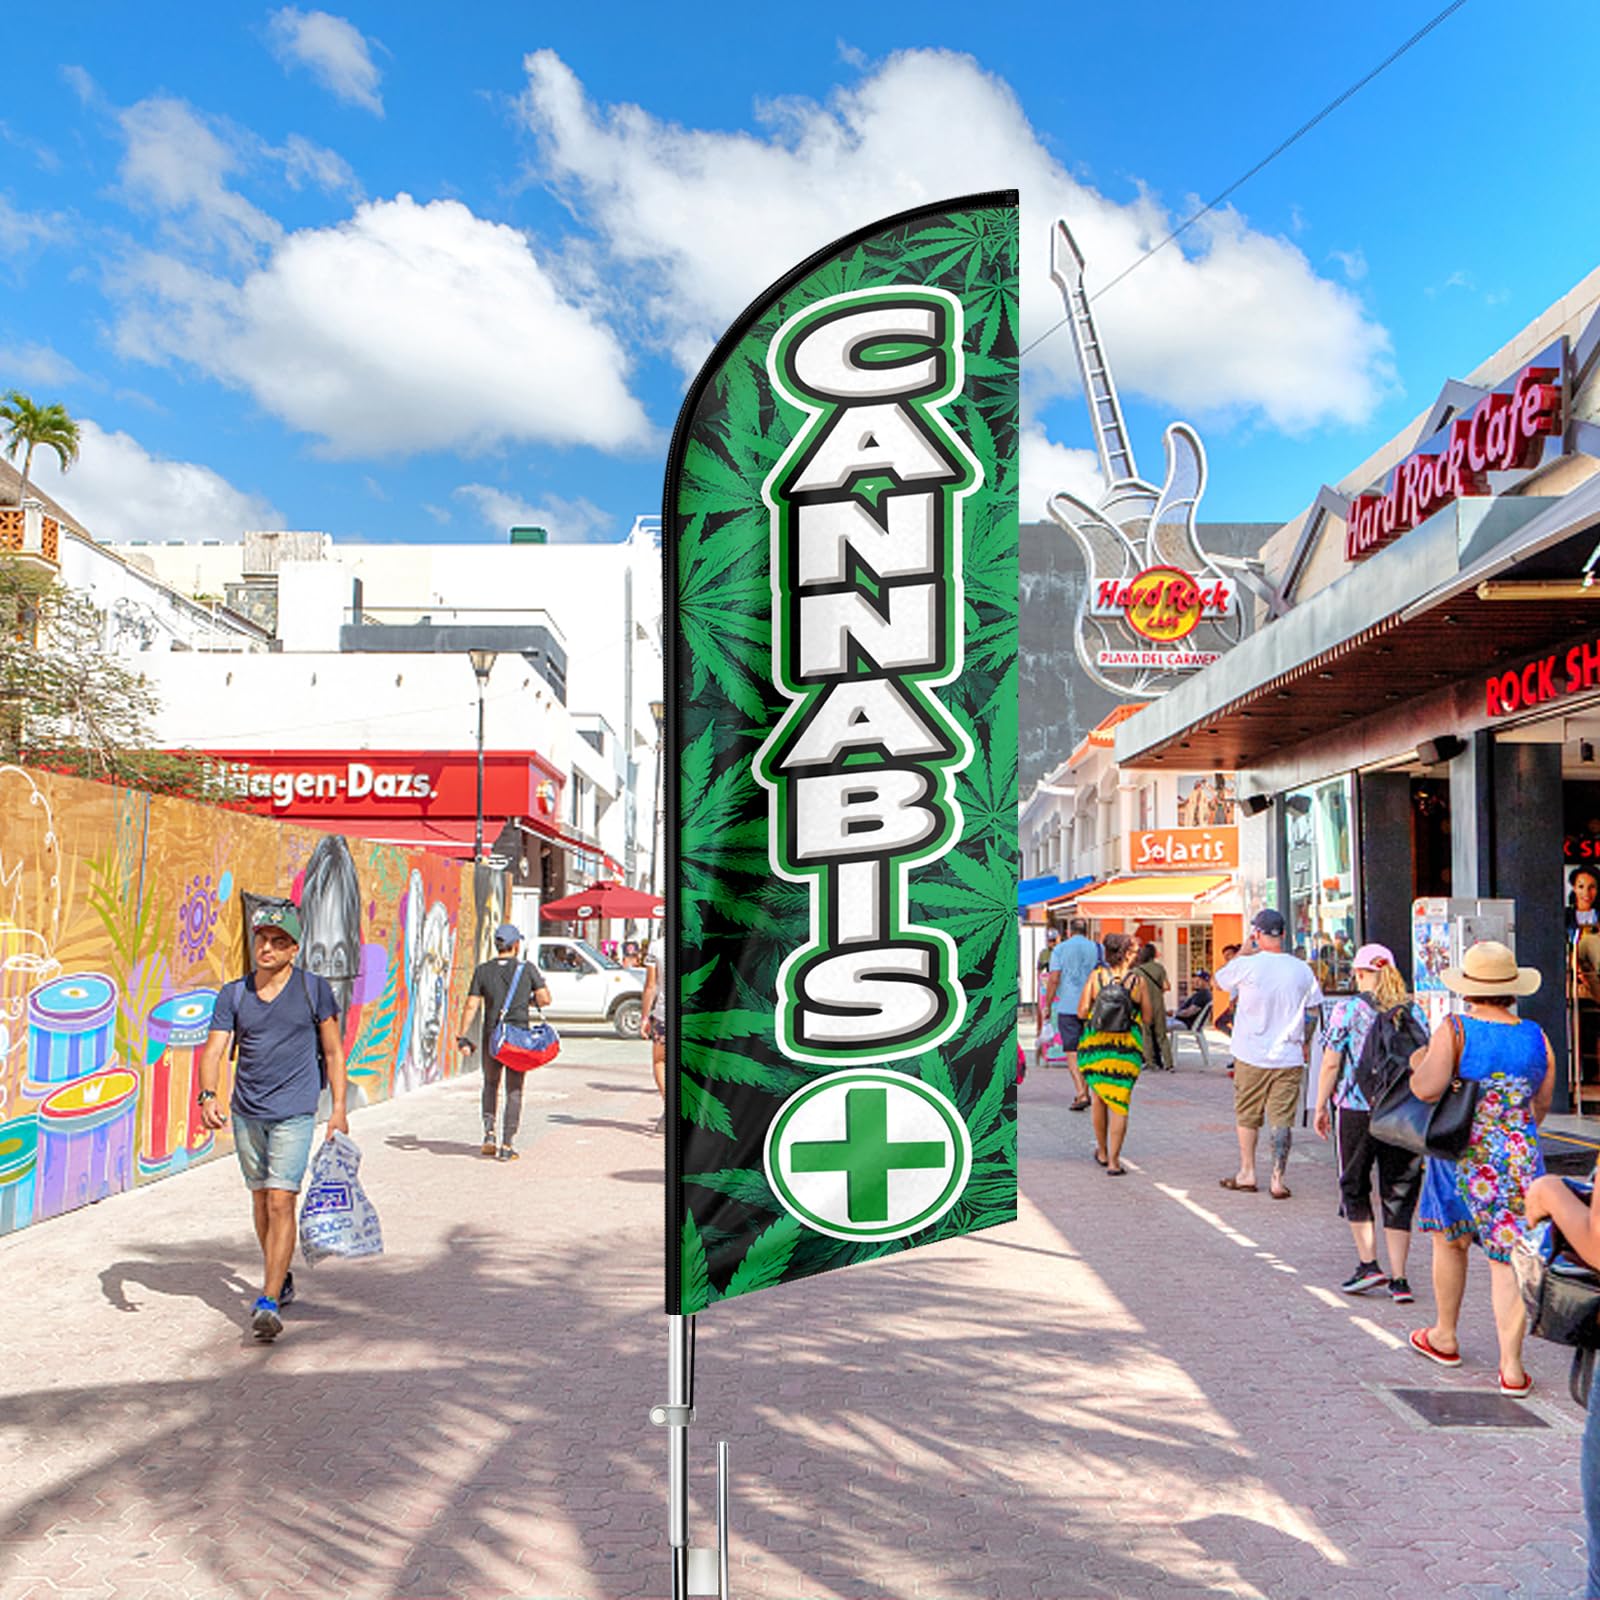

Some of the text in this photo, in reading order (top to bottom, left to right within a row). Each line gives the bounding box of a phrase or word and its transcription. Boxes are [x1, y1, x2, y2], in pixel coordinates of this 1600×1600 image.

[1344, 367, 1546, 562] Hard Rock Cafe
[1097, 580, 1231, 613] Hard Rock
[776, 300, 966, 1052] CANNABIS
[1100, 652, 1139, 665] PLAYA
[1141, 652, 1163, 665] DEL
[1486, 655, 1557, 717] ROCK
[1137, 832, 1225, 863] Solaris
